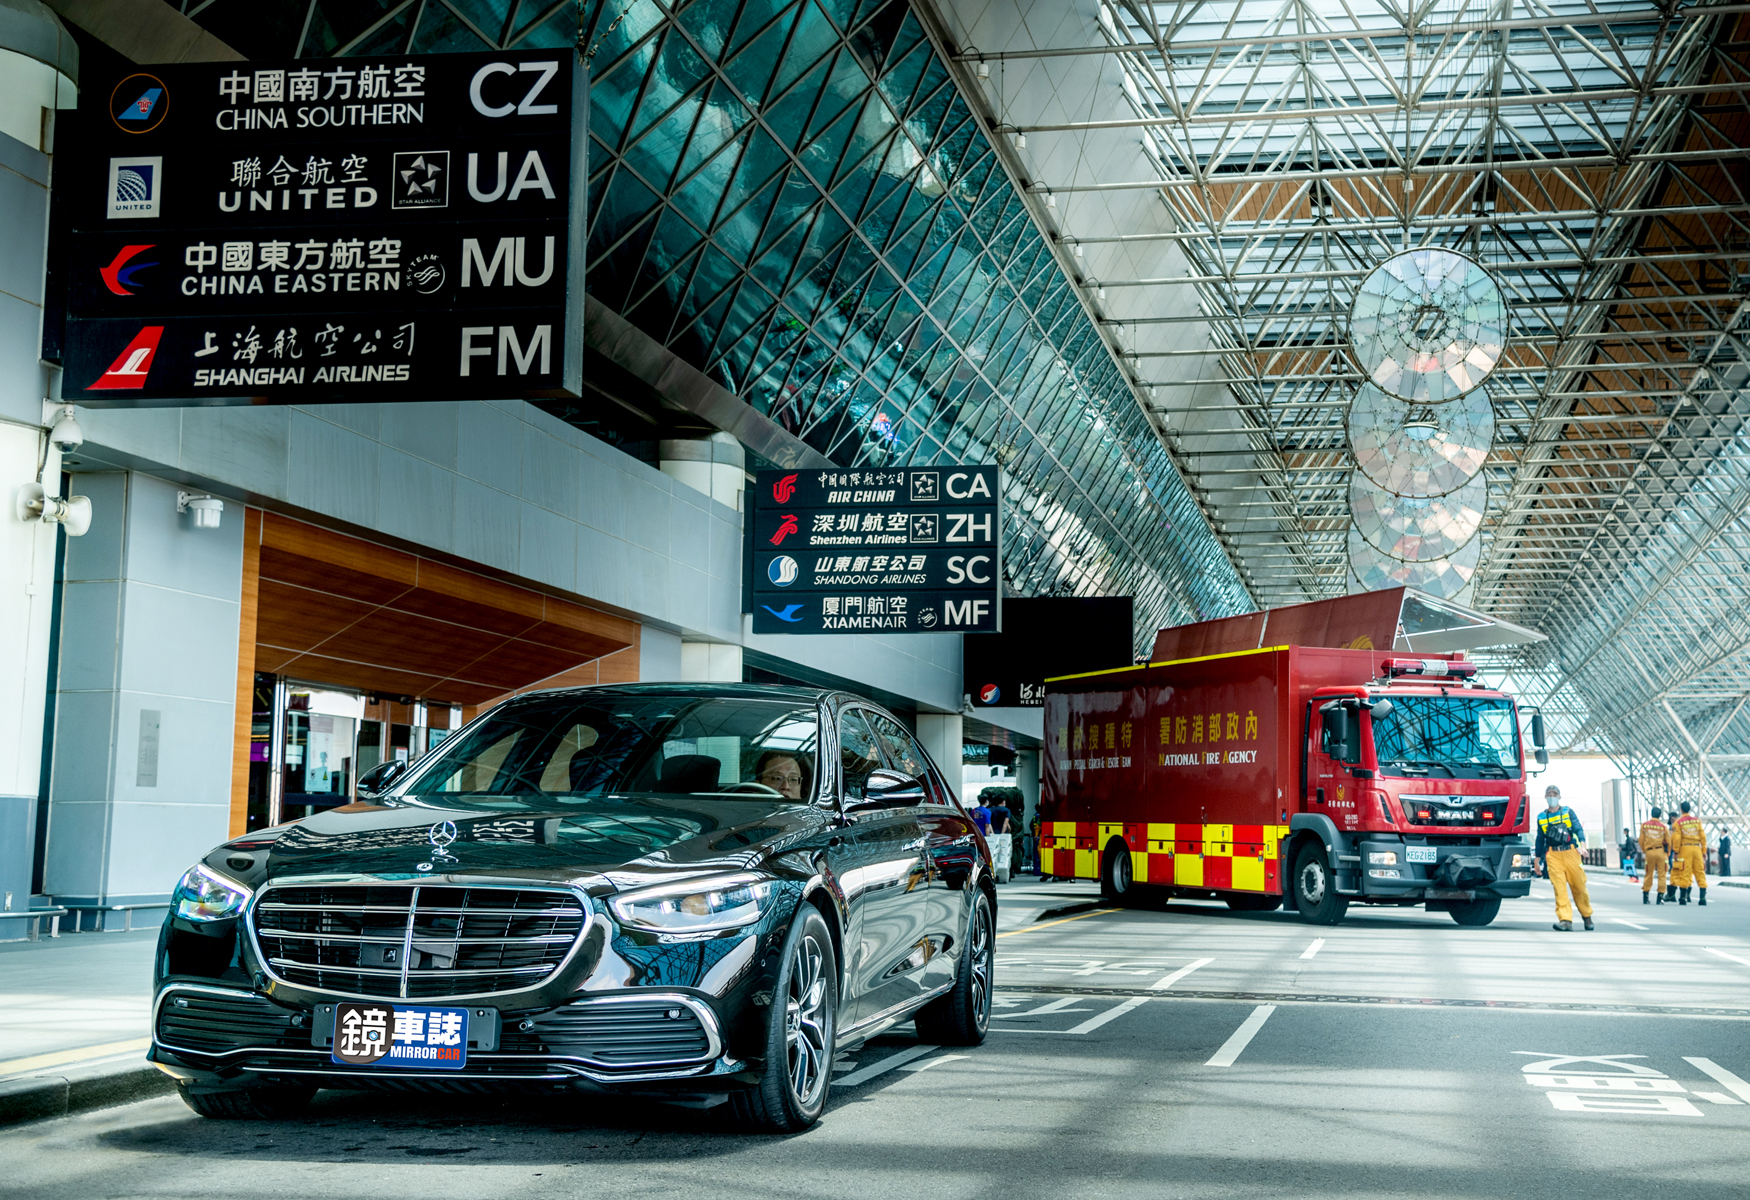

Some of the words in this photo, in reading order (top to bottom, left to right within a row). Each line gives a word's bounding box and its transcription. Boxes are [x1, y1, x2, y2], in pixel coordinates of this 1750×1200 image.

[219, 63, 426, 105] 中國南方航空
[469, 61, 559, 118] CZ
[216, 107, 289, 131] CHINA
[296, 103, 424, 128] SOUTHERN
[230, 154, 369, 188] 聯合航空
[467, 150, 556, 203] UA
[218, 186, 378, 213] UNITED
[185, 237, 402, 274] 中國東方航空
[461, 235, 555, 288] MU
[181, 275, 263, 296] CHINA
[274, 271, 400, 294] EASTERN
[195, 322, 415, 364] 上海航空公司
[460, 324, 551, 377] FM
[194, 367, 304, 386] SHANGHAI
[313, 364, 410, 384] AIRLINES
[827, 491, 852, 503] AIR
[853, 490, 896, 503] CHINA
[946, 473, 991, 499] CA
[811, 512, 909, 533] 深圳航空
[945, 513, 991, 543] ZH
[809, 535, 862, 545] Shenzhen
[864, 534, 908, 545] Airlines
[814, 555, 927, 573] 山東航空公司
[946, 555, 991, 584] SC
[813, 574, 879, 585] SHANDONG
[880, 574, 927, 584] AIRLINES
[822, 616, 907, 629] XIAMENAIR
[944, 600, 990, 625] MF
[1159, 753, 1199, 766] NATIONAL
[1202, 751, 1220, 765] FIRE
[1222, 750, 1257, 764] AGENCY
[1437, 810, 1474, 819] MAN
[390, 1046, 460, 1060] MIRRORCAR
